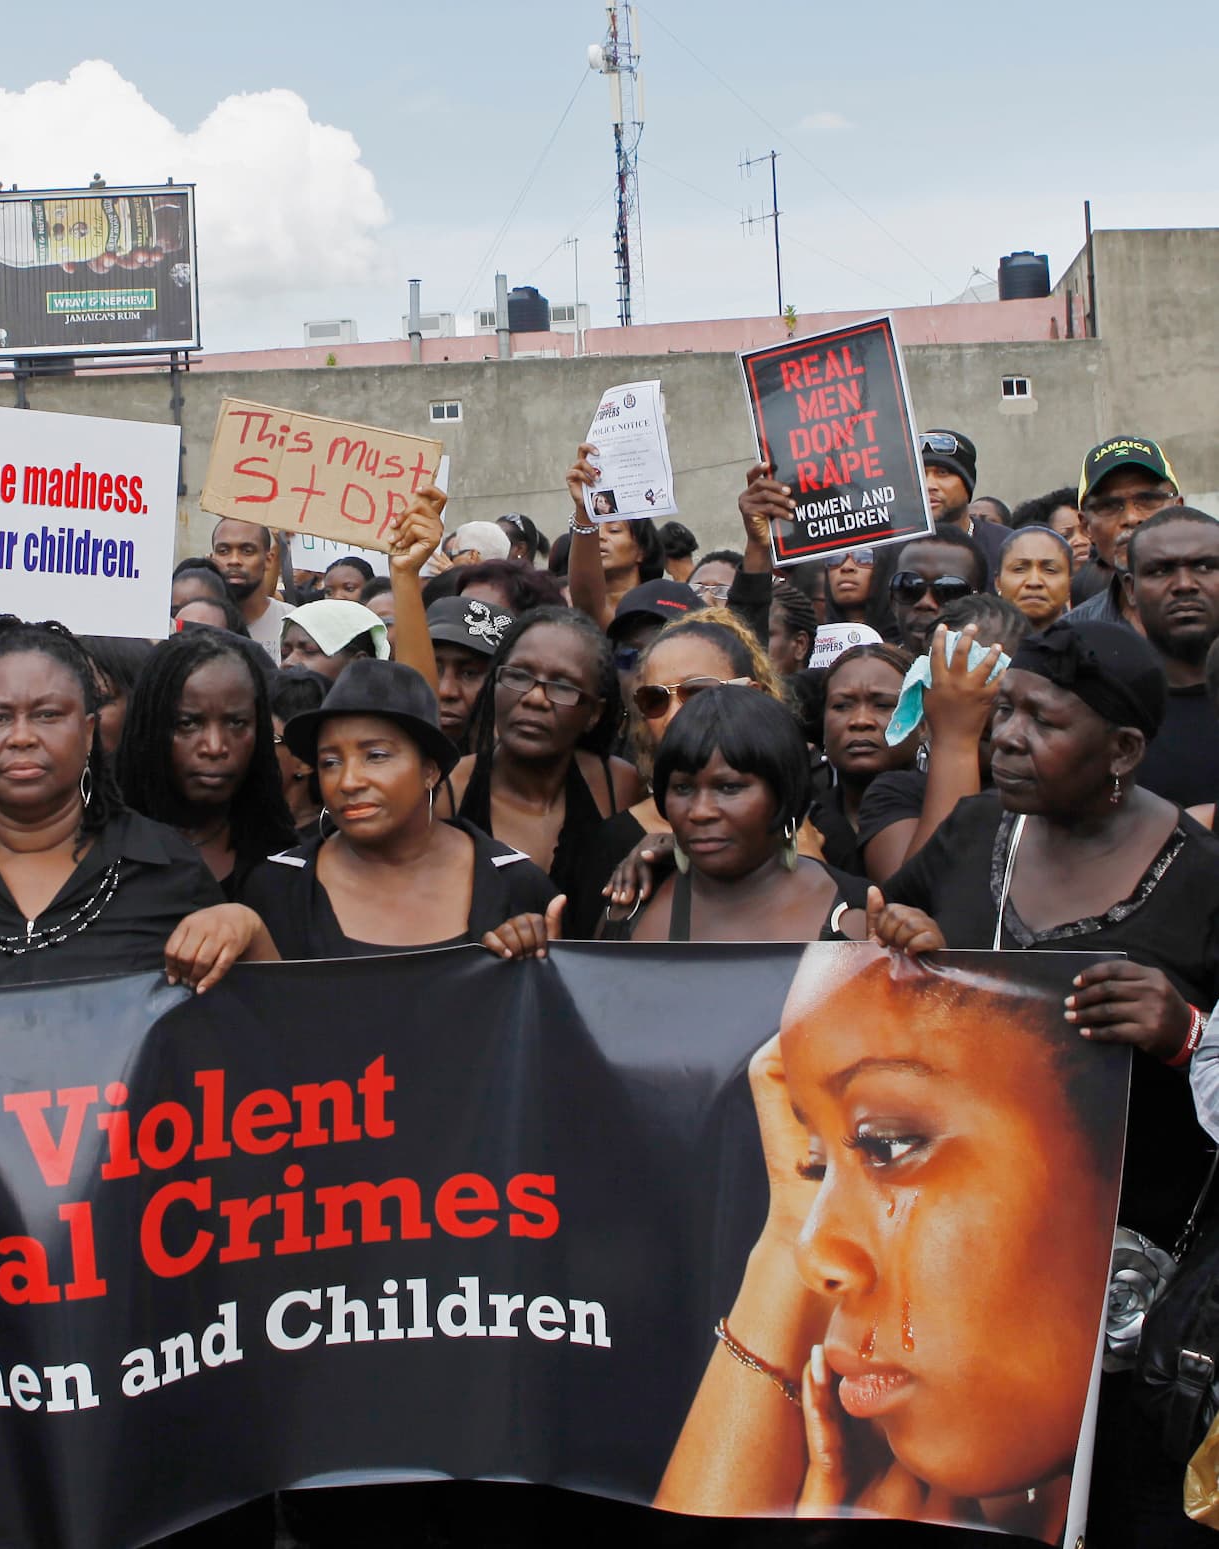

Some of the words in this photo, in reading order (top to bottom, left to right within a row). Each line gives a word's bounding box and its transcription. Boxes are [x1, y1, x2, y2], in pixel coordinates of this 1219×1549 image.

[54, 298, 86, 308] WRAY
[89, 297, 98, 307] &
[101, 295, 148, 306] NEPHEW
[64, 312, 116, 325] JAMAICA'S
[117, 311, 140, 321] RUM
[780, 346, 866, 392] REAL
[796, 379, 862, 424] MEN
[228, 410, 313, 453] This
[789, 411, 878, 461] DON'T
[1094, 440, 1152, 463] JAMAICA
[22, 463, 148, 514] madness.
[796, 446, 884, 494] RAPE
[795, 495, 851, 522] WOMEN
[861, 486, 896, 509] AND
[807, 507, 890, 542] CHILDREN
[23, 526, 139, 579] children.
[3, 1054, 396, 1188] Violent
[140, 1164, 561, 1279] Crimes
[121, 1302, 244, 1399] and
[265, 1276, 612, 1352] Children
